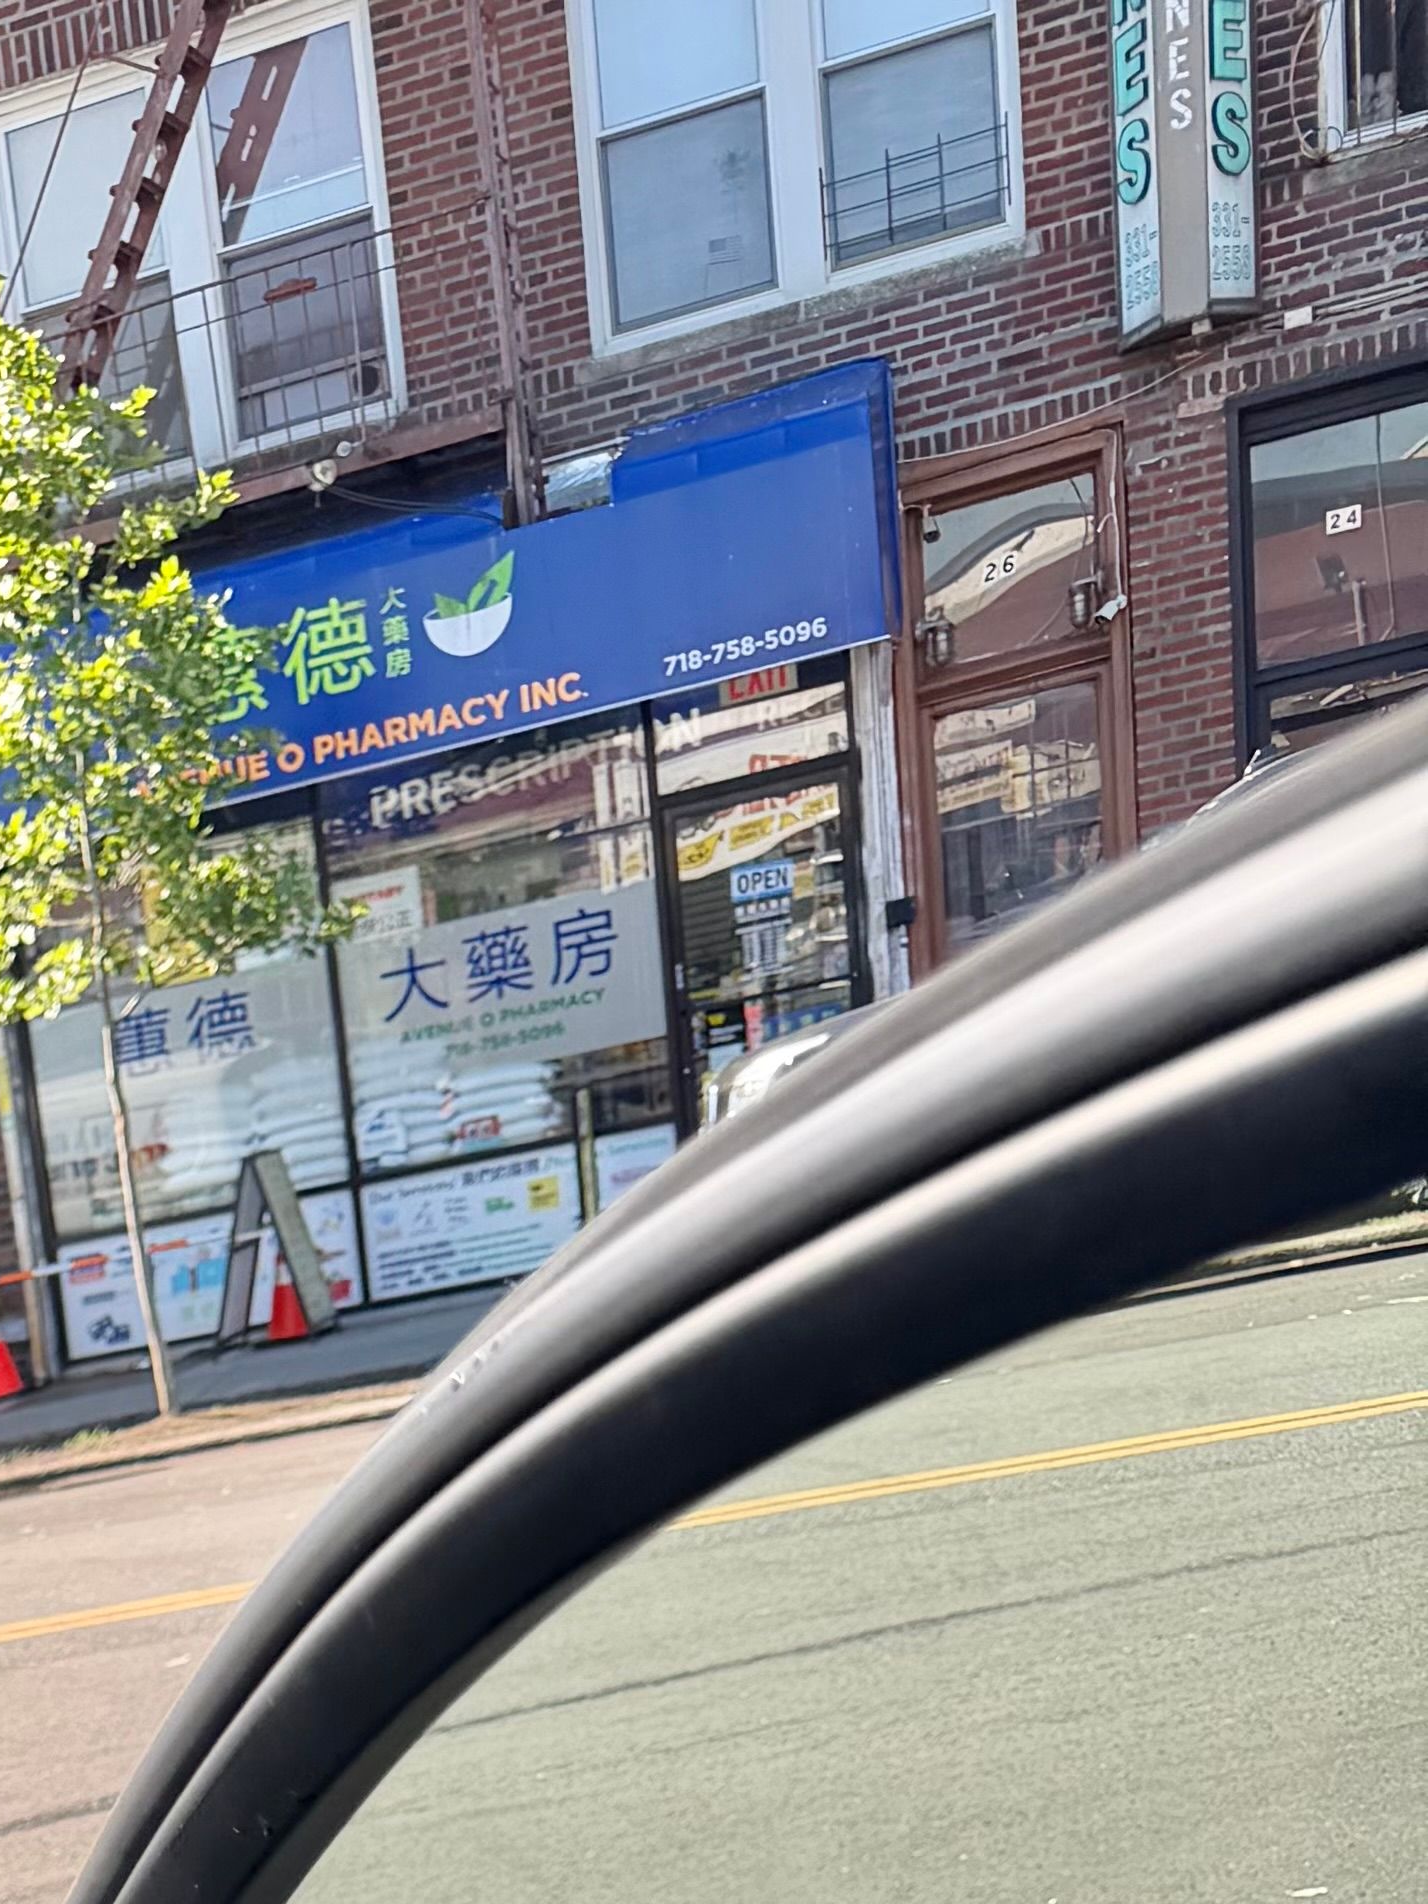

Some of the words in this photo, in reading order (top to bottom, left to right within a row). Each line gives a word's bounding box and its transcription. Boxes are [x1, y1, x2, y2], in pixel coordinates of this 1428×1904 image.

[983, 553, 1017, 584] 26
[378, 586, 413, 680] 大藥房
[662, 616, 828, 678] 718-758-5096
[276, 742, 305, 773] O
[313, 688, 511, 766] PHARMACY
[519, 672, 590, 714] INC.
[369, 707, 702, 829] PRESCRIPTION
[736, 867, 789, 895] OPEN
[380, 908, 619, 1023] 大藥房
[479, 1013, 494, 1028] O
[498, 987, 607, 1026] PHARMACY
